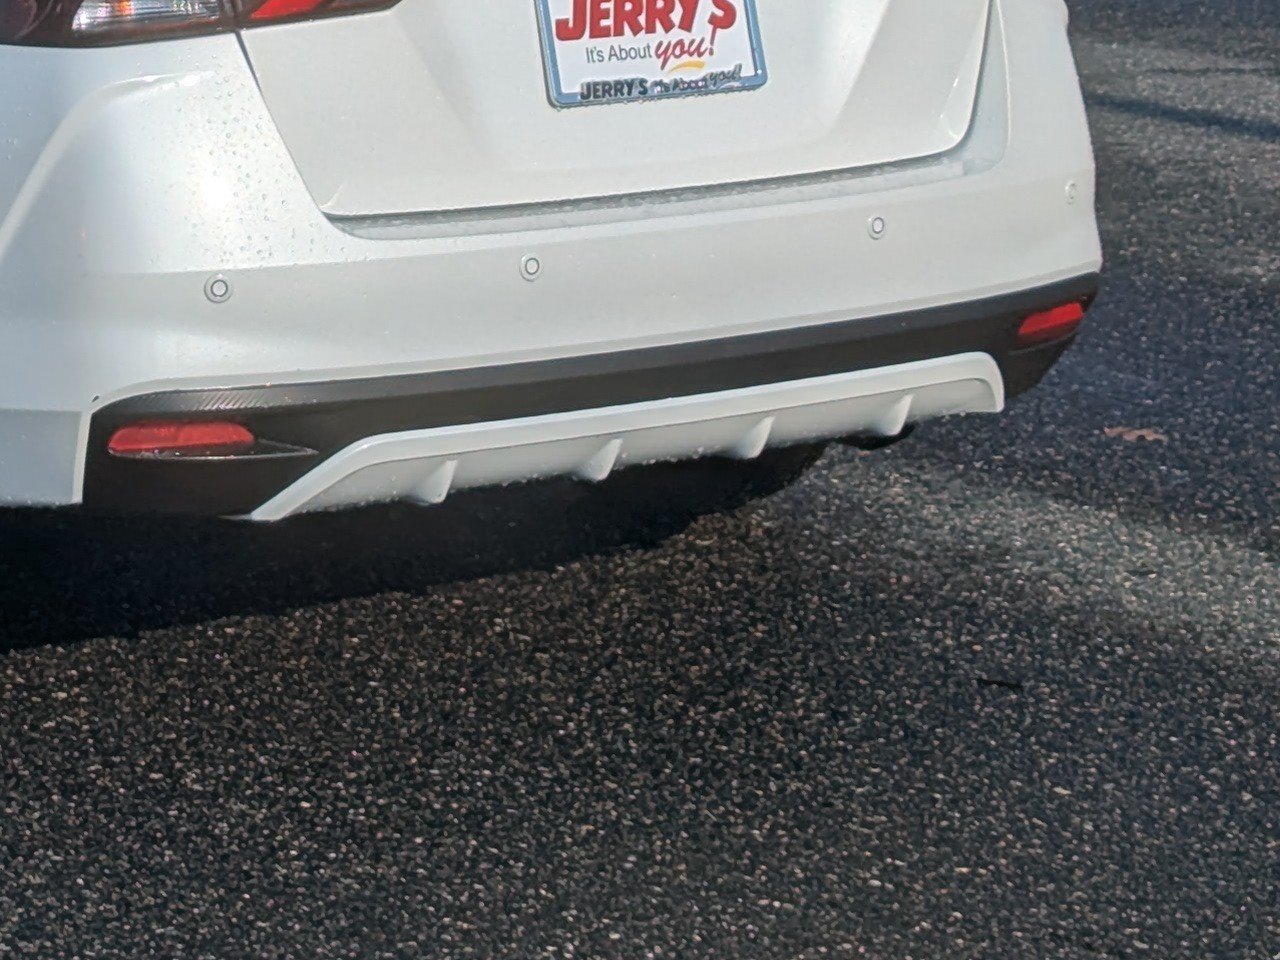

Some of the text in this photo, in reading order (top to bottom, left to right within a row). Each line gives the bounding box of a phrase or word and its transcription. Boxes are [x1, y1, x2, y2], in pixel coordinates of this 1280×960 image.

[586, 25, 716, 70] It's About you!
[580, 77, 648, 100] JERRY'S
